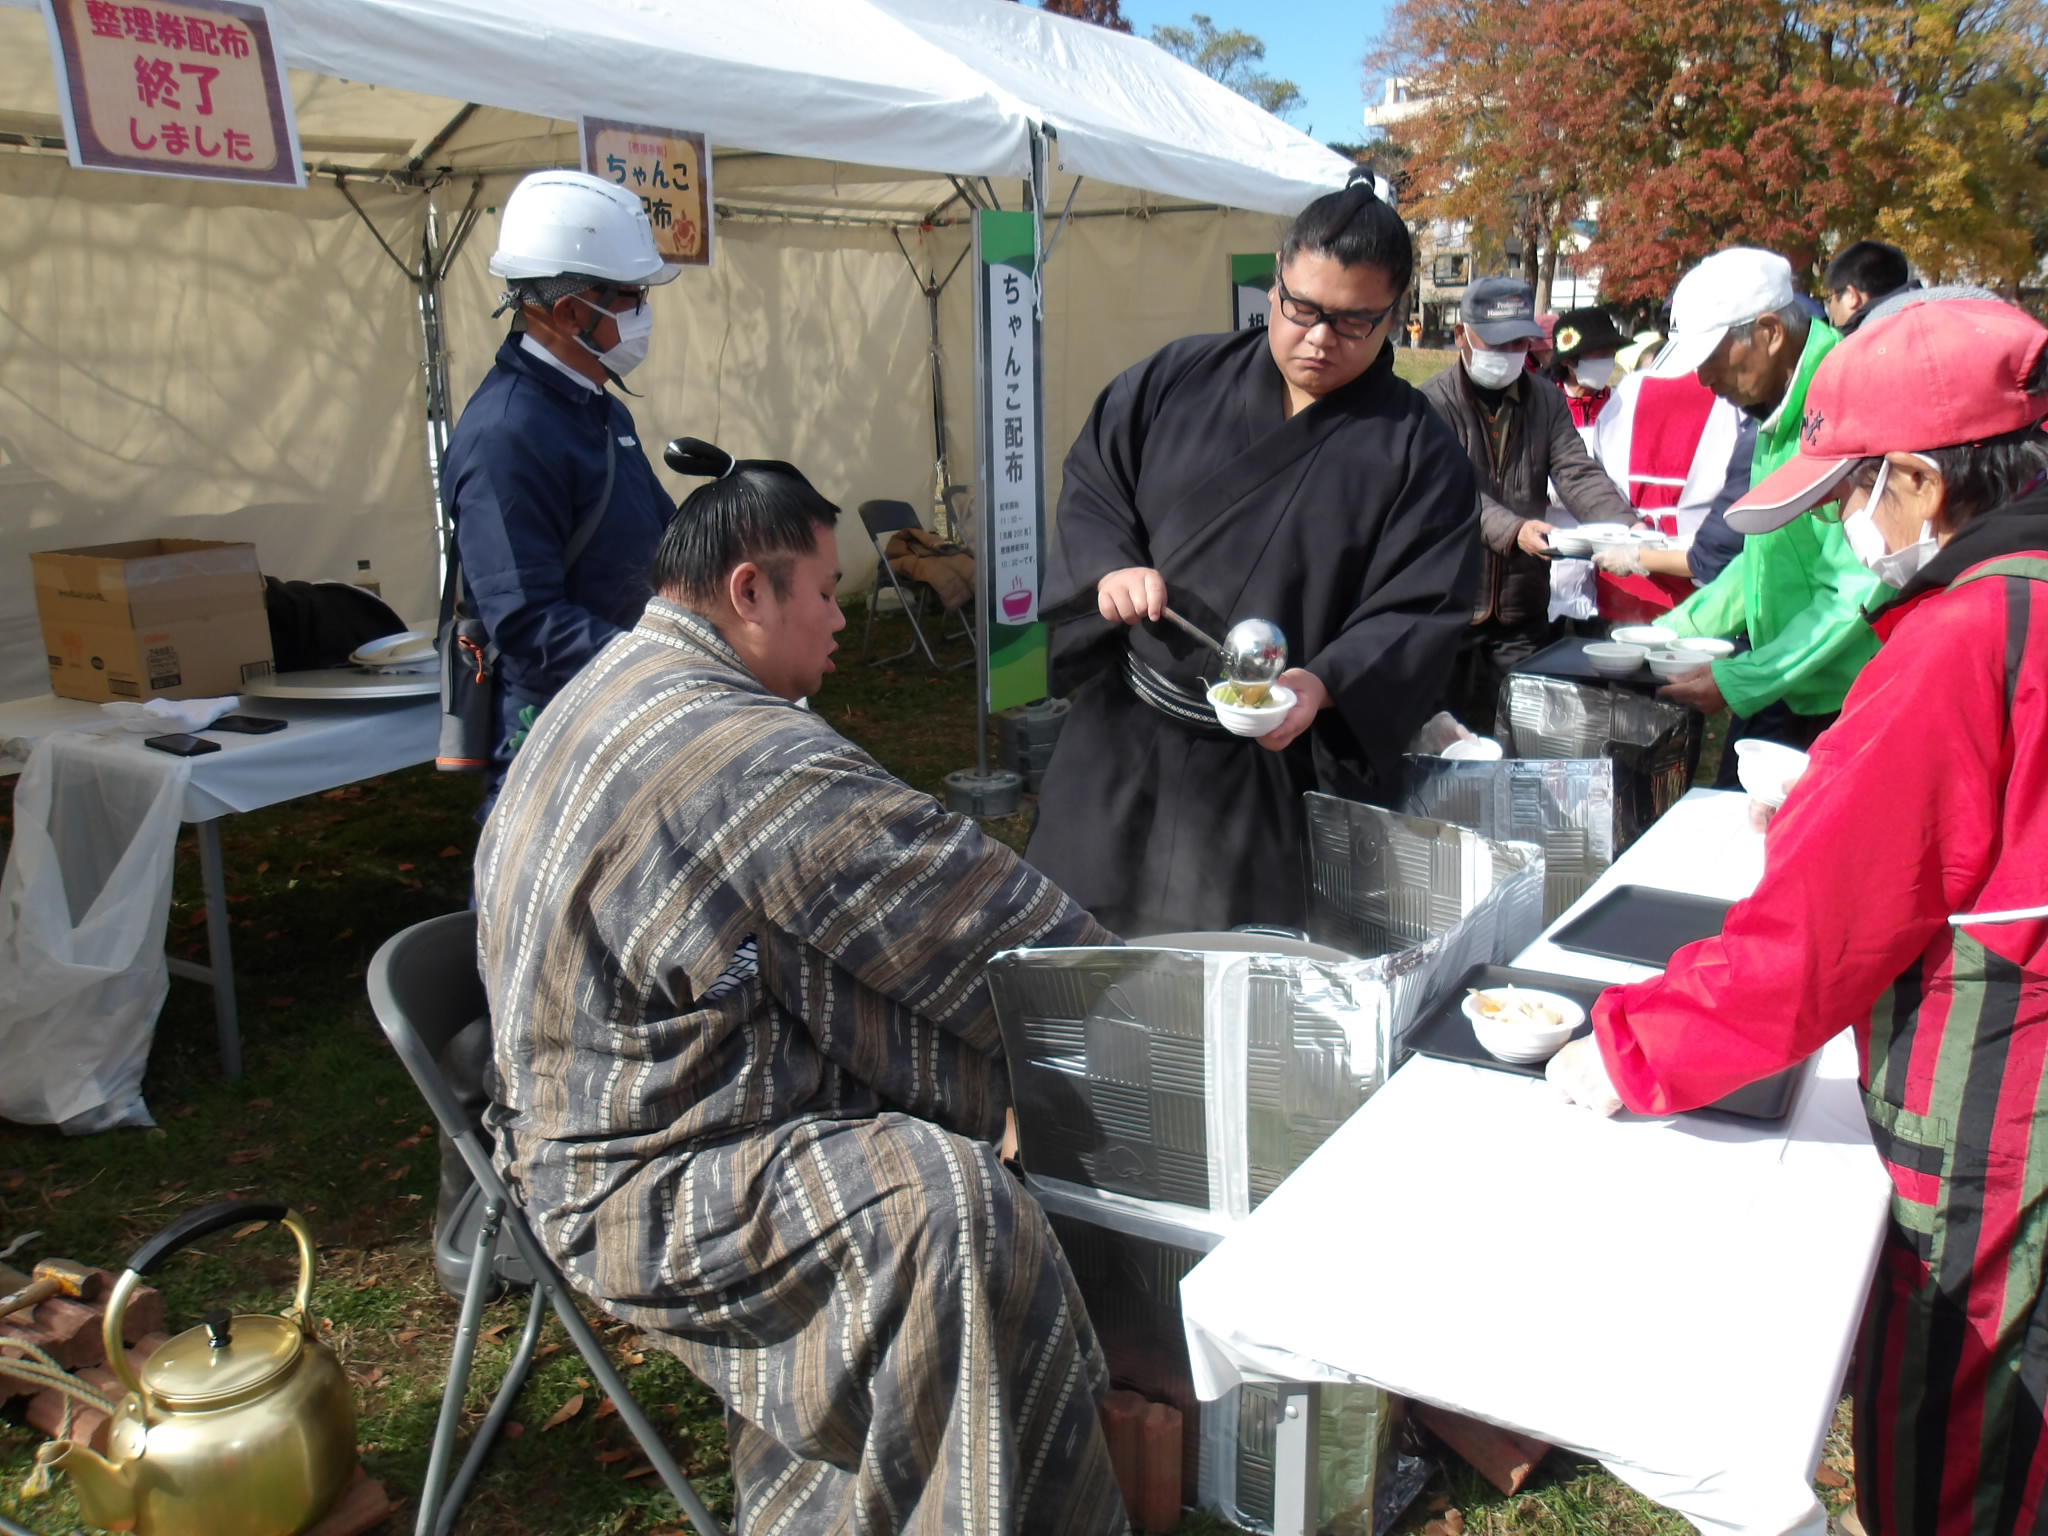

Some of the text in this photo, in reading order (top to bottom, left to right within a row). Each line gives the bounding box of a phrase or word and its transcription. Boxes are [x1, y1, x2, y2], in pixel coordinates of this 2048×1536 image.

[86, 0, 250, 59] 整理券配布
[133, 55, 220, 115] 終了
[129, 117, 254, 162] しました
[606, 153, 690, 191] ちゃんこ
[1003, 273, 1024, 484] ちゃんこ配布
